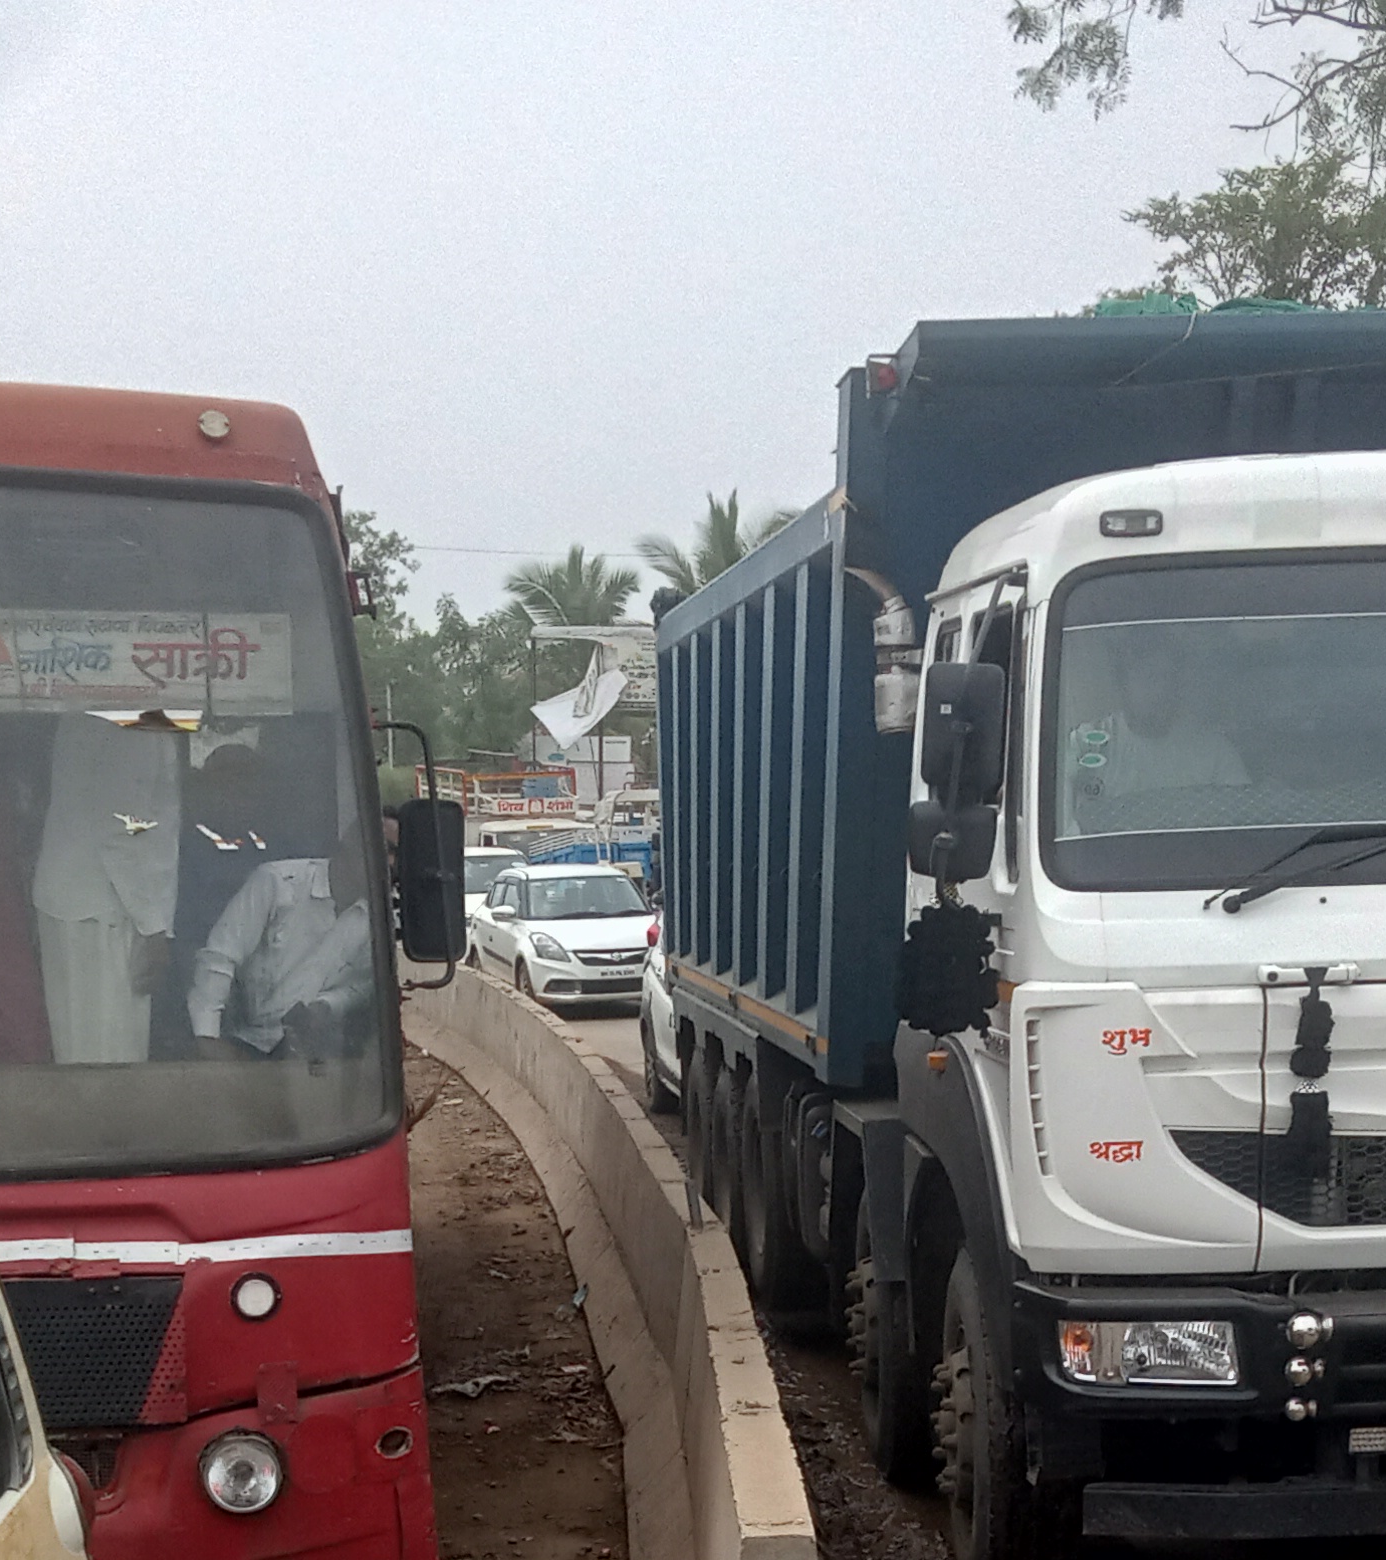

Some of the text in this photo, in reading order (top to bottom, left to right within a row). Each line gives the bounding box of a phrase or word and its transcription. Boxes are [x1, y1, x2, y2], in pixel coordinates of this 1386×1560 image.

[132, 628, 261, 689] साक्री
[1102, 1027, 1152, 1055] शुभ
[1089, 1140, 1143, 1163] श्रद्धा
